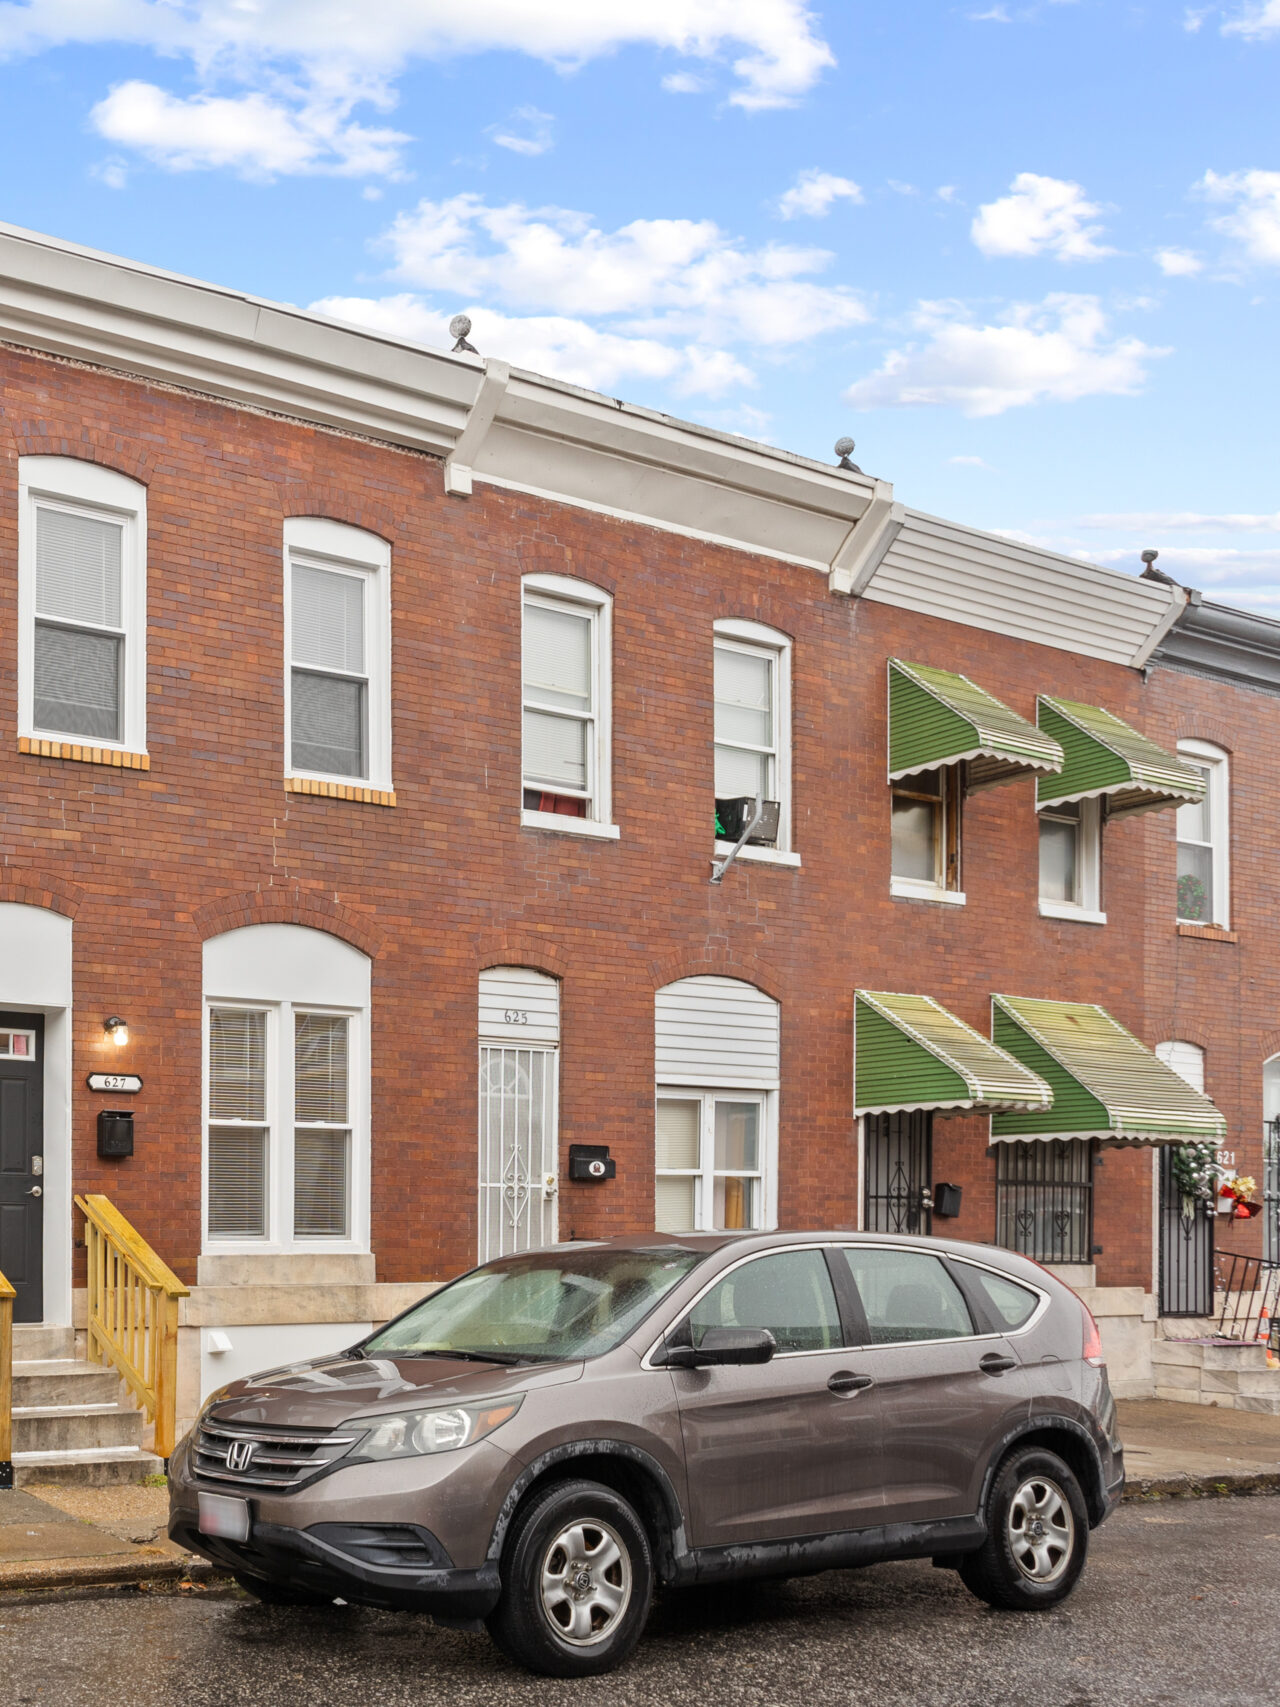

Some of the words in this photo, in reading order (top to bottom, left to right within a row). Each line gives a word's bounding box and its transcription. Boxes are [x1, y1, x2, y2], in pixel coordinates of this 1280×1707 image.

[504, 1009, 528, 1024] 625
[104, 1077, 126, 1088] 627
[1216, 1150, 1235, 1165] 621
